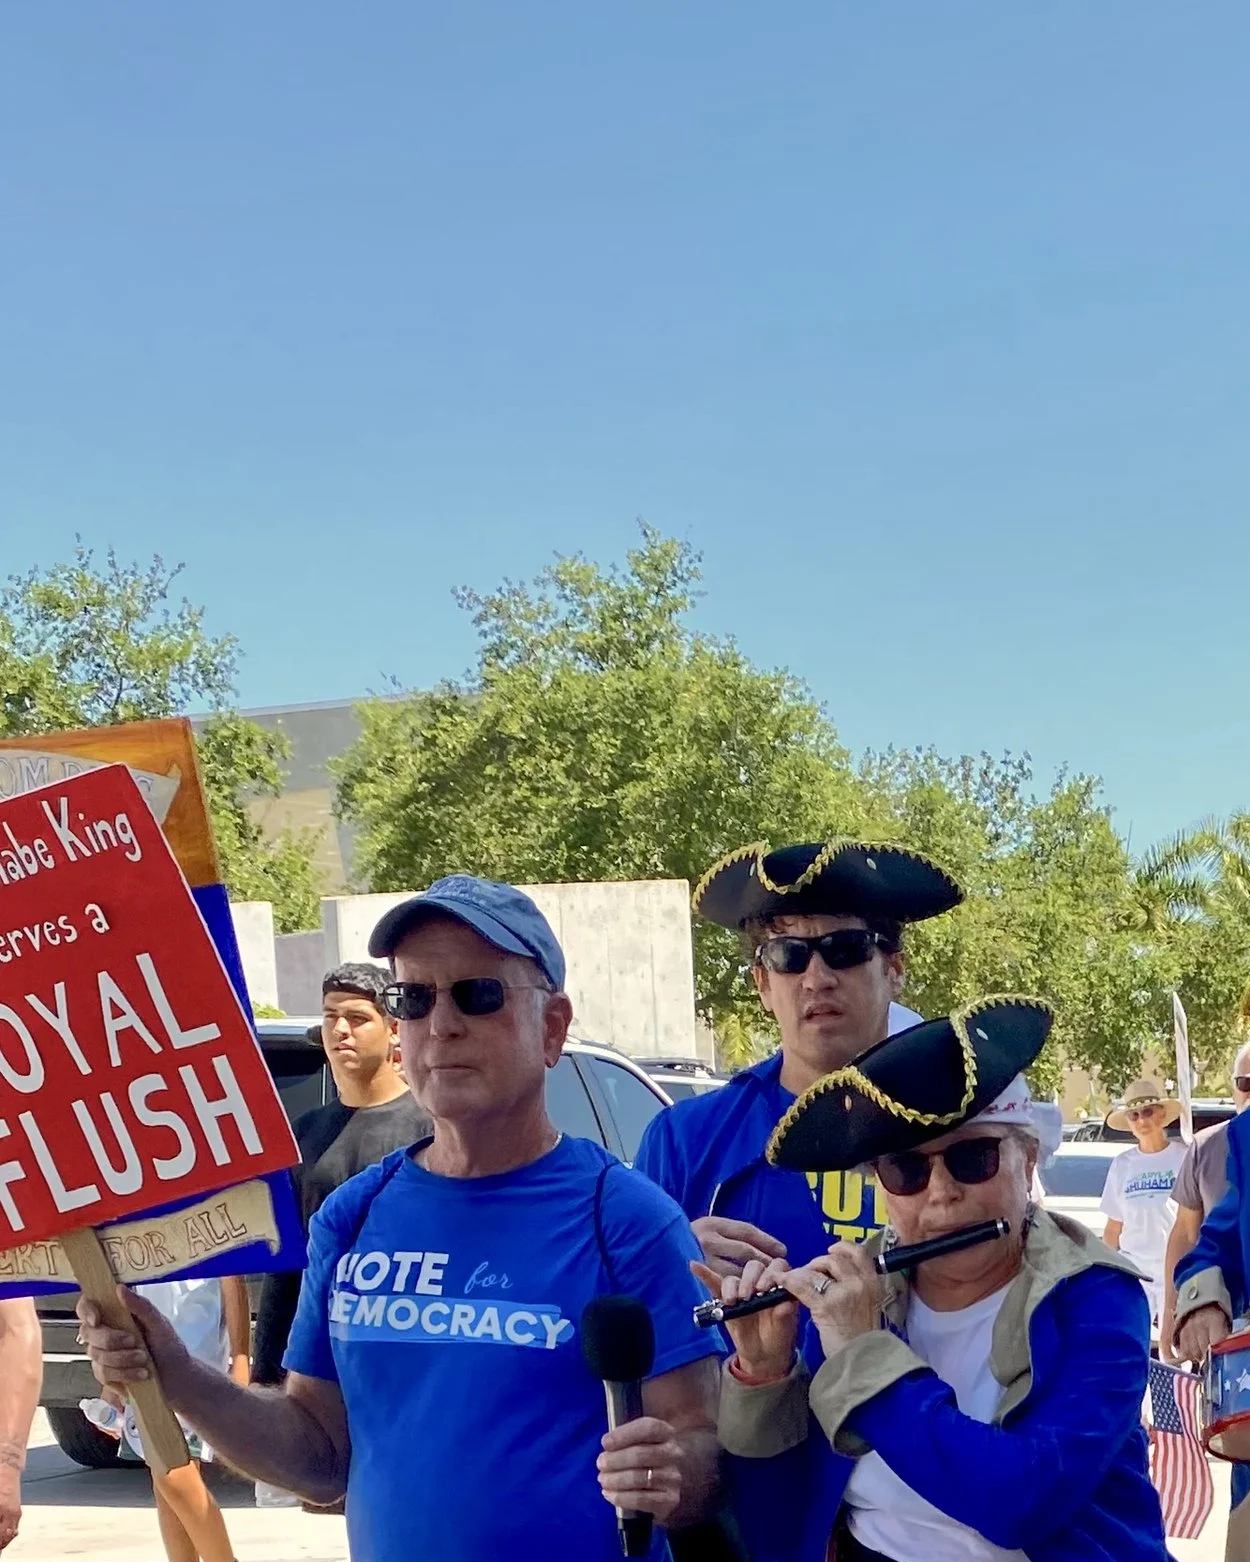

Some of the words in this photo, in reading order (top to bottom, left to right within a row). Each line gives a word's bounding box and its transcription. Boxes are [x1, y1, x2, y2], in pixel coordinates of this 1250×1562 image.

[41, 797, 142, 862] King
[84, 903, 110, 934] a
[182, 1203, 248, 1258] ALL
[463, 1261, 513, 1294] for
[329, 1289, 571, 1350] EMOCRACY
